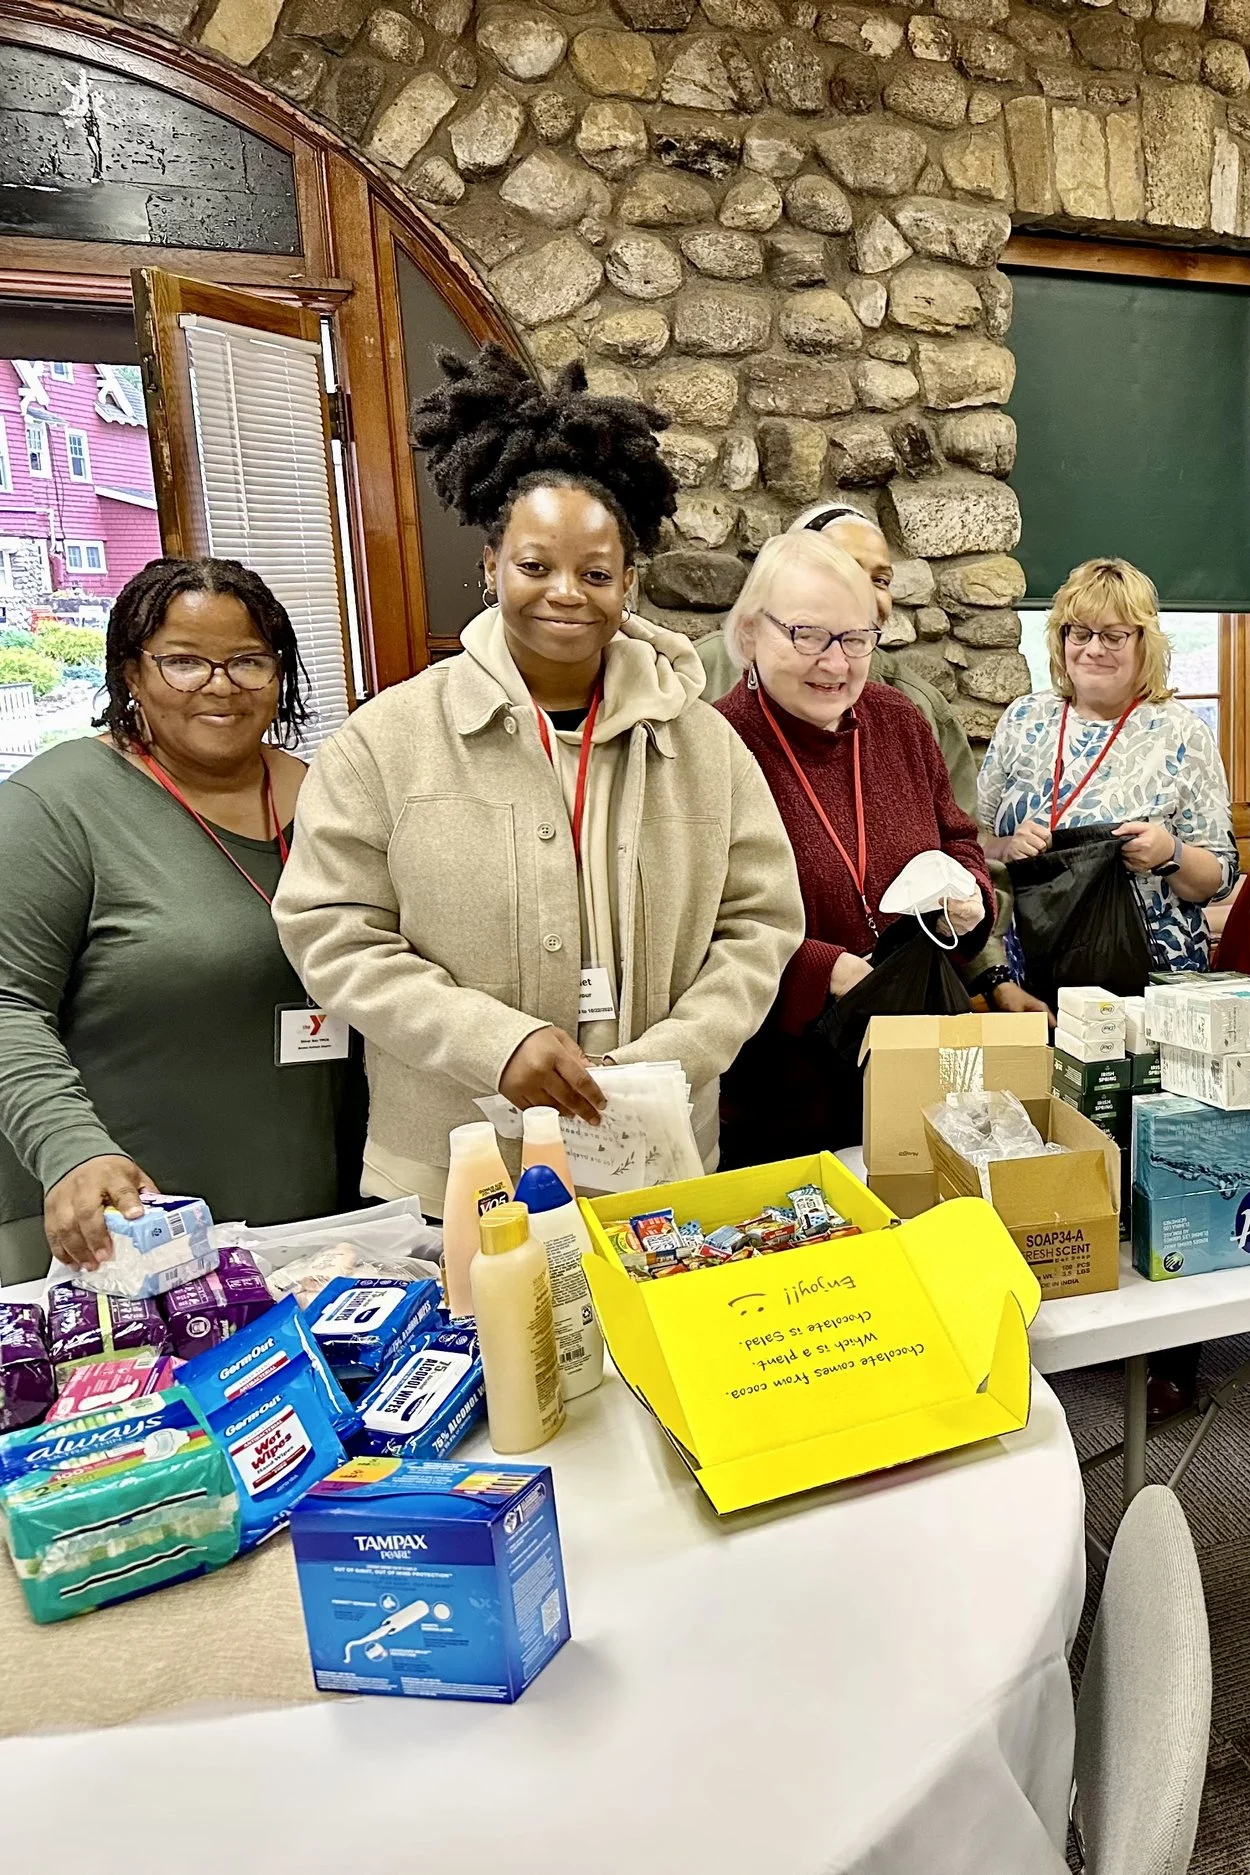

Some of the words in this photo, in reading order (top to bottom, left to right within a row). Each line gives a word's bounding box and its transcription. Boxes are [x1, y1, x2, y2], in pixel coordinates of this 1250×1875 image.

[480, 1194, 506, 1215] VO5
[1056, 1243, 1091, 1257] SCENT
[784, 1276, 857, 1305] Enjoy!!
[789, 1327, 803, 1336] is
[808, 1310, 872, 1333] Chocolate
[739, 1331, 785, 1351] Salad.
[816, 1344, 830, 1354] is
[835, 1332, 878, 1351] Which
[219, 1336, 275, 1380] GermOut
[752, 1349, 798, 1372] plant.
[803, 1349, 812, 1358] a
[860, 1343, 925, 1366] Chocolate
[405, 1358, 439, 1392] ALCOHOL
[773, 1371, 810, 1385] from
[814, 1360, 855, 1377] comes
[726, 1382, 767, 1399] cocoa.
[384, 1391, 413, 1414] WIPES
[224, 1394, 282, 1437] GermOut
[432, 1430, 450, 1453] 75%
[447, 1393, 479, 1433] ALCOHOL
[26, 1415, 165, 1462] always
[47, 1446, 90, 1461] ULTRA
[93, 1436, 122, 1448] THIN
[254, 1430, 281, 1454] Wet
[275, 1445, 294, 1464] Wipes
[35, 1487, 50, 1496] 2
[353, 1534, 428, 1551] TAMPAX
